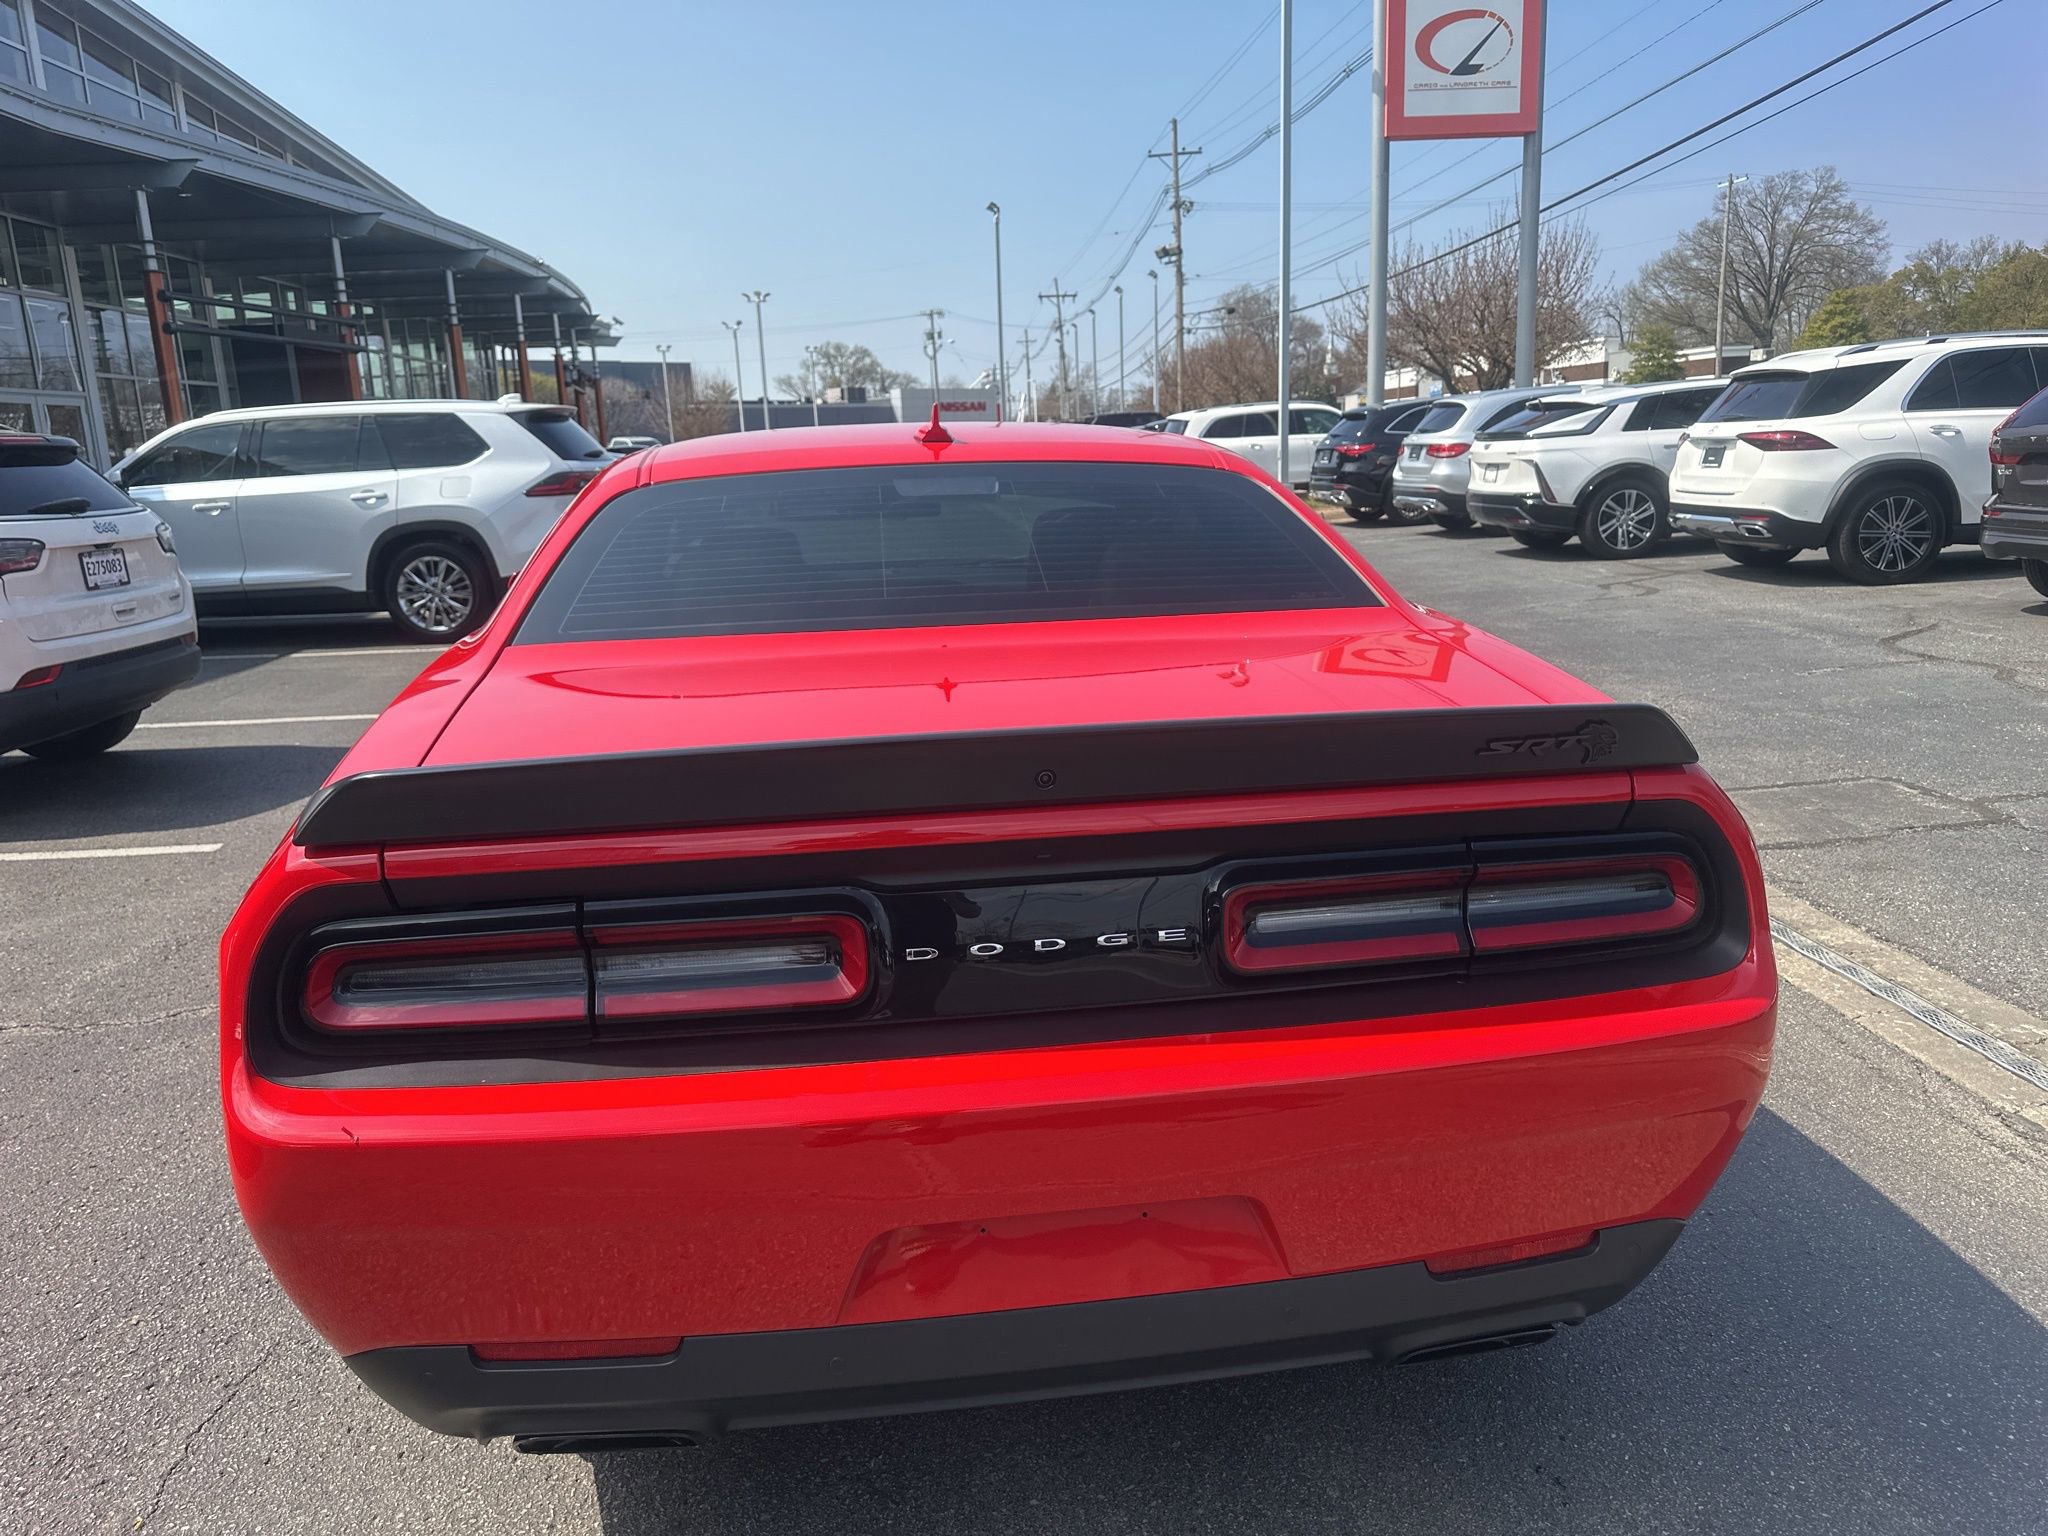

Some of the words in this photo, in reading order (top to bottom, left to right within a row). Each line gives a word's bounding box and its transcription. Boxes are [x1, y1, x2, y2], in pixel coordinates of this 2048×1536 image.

[940, 401, 986, 412] NISSAN
[86, 558, 123, 577] E275083
[1477, 735, 1589, 757] SRT
[906, 929, 1187, 961] DODGE
